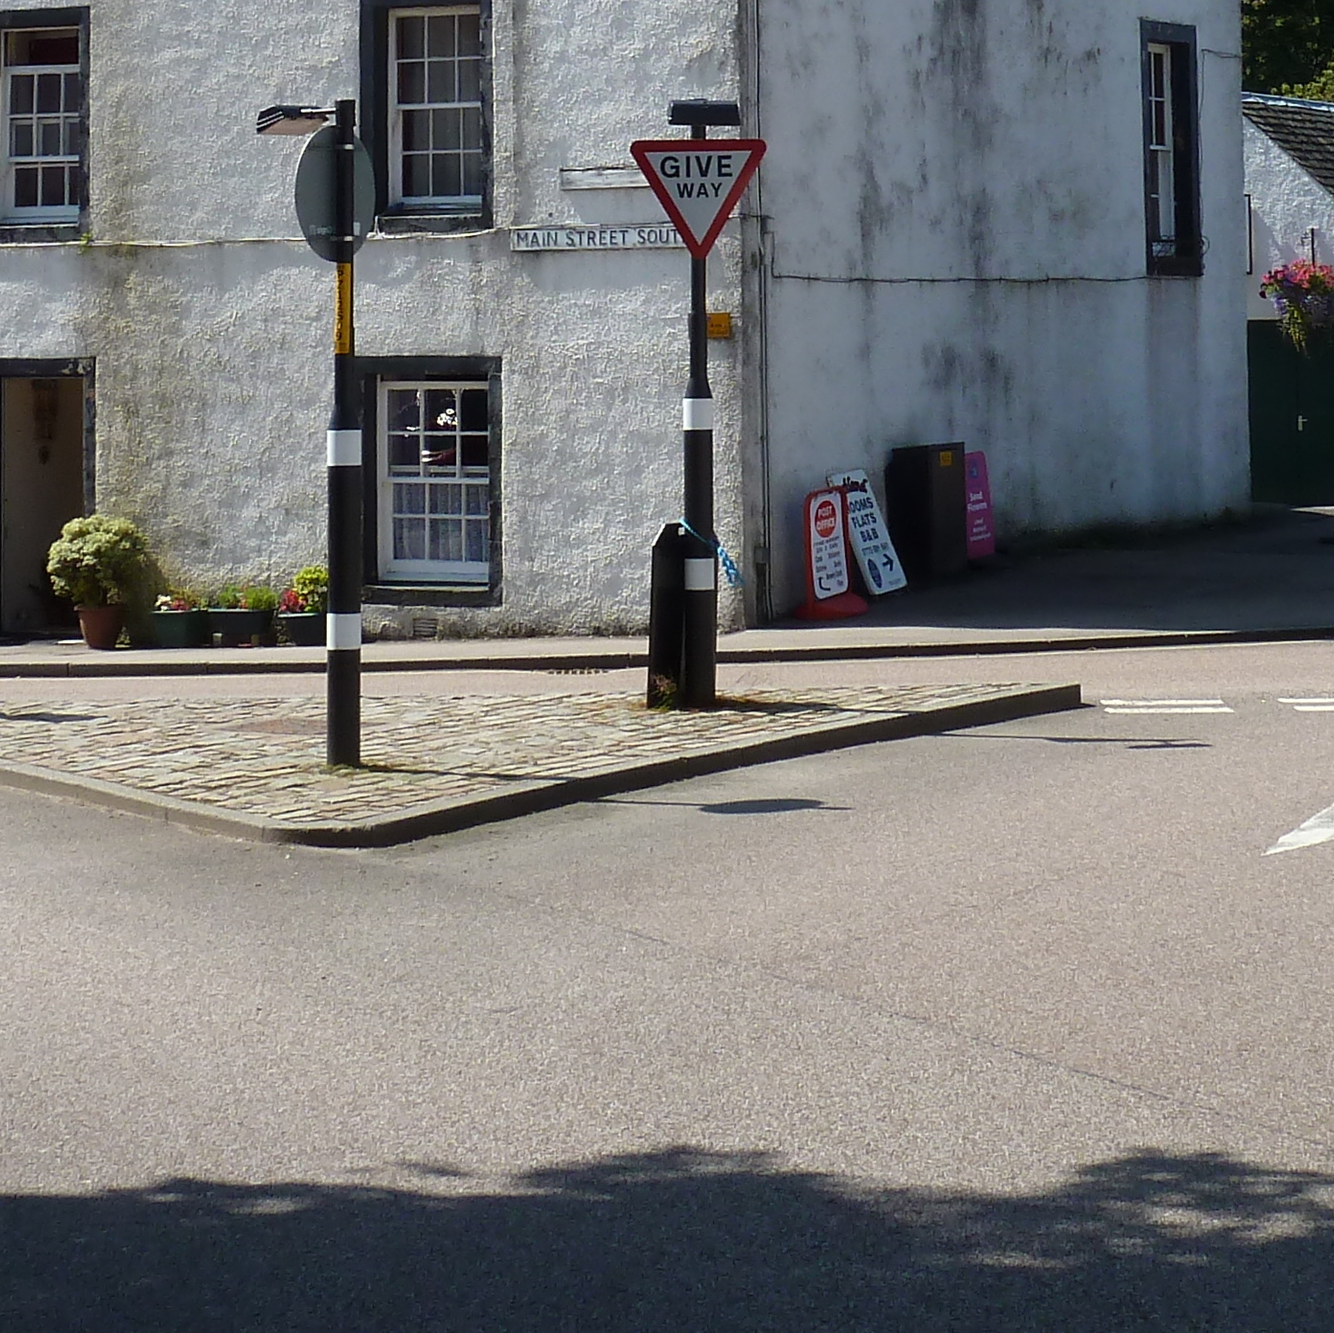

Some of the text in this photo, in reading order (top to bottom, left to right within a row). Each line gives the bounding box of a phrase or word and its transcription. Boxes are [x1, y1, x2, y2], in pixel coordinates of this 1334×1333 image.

[660, 155, 733, 178] GIVE
[677, 183, 723, 198] WAY
[516, 229, 678, 247] MAIN STREET SOUT
[817, 506, 832, 517] POST
[848, 496, 874, 513] OOMS
[816, 517, 835, 530] OFFICE
[851, 512, 877, 529] FLATS
[859, 528, 879, 542] B&B
